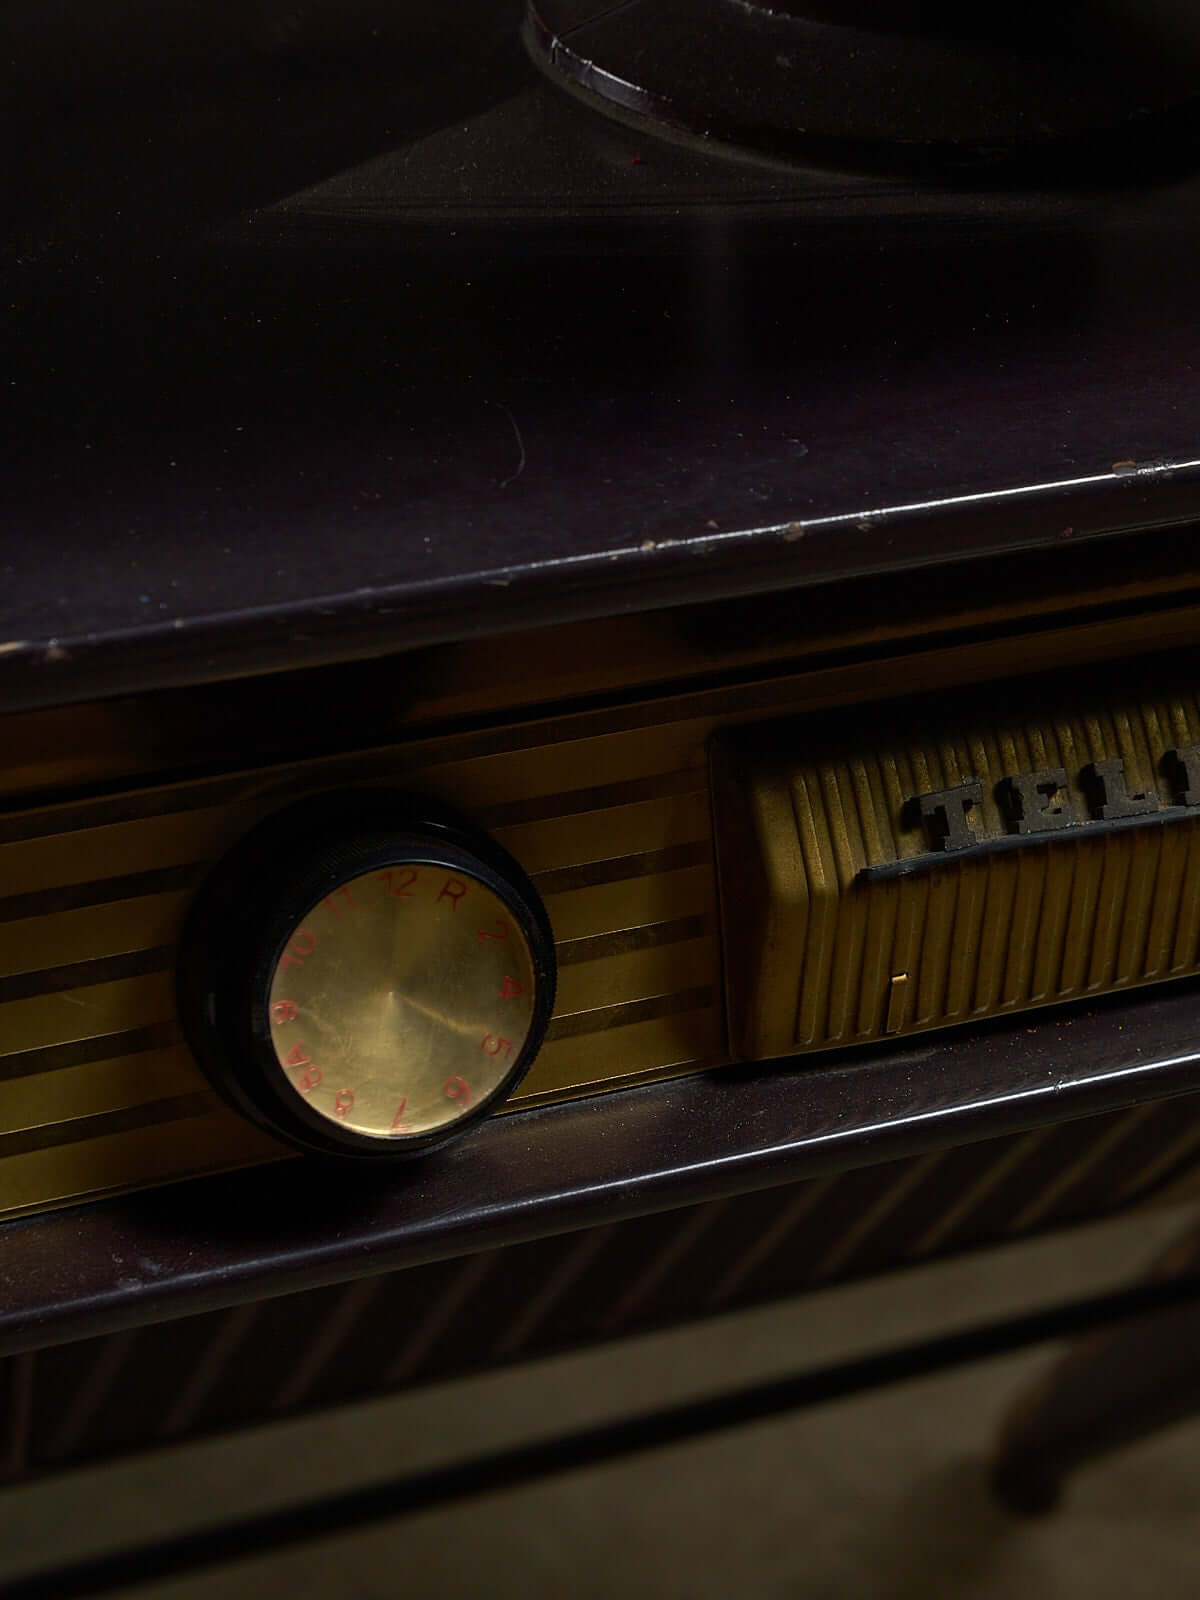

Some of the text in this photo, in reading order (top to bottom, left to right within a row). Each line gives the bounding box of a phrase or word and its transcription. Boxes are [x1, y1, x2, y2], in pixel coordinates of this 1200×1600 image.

[377, 870, 418, 898] 12
[437, 877, 468, 912] R
[323, 887, 357, 920] 11
[280, 929, 317, 972] 10
[496, 976, 523, 1001] 4
[270, 999, 298, 1025] 9
[481, 1033, 513, 1060] 5
[333, 1088, 356, 1118] 8
[391, 1096, 413, 1130] 7
